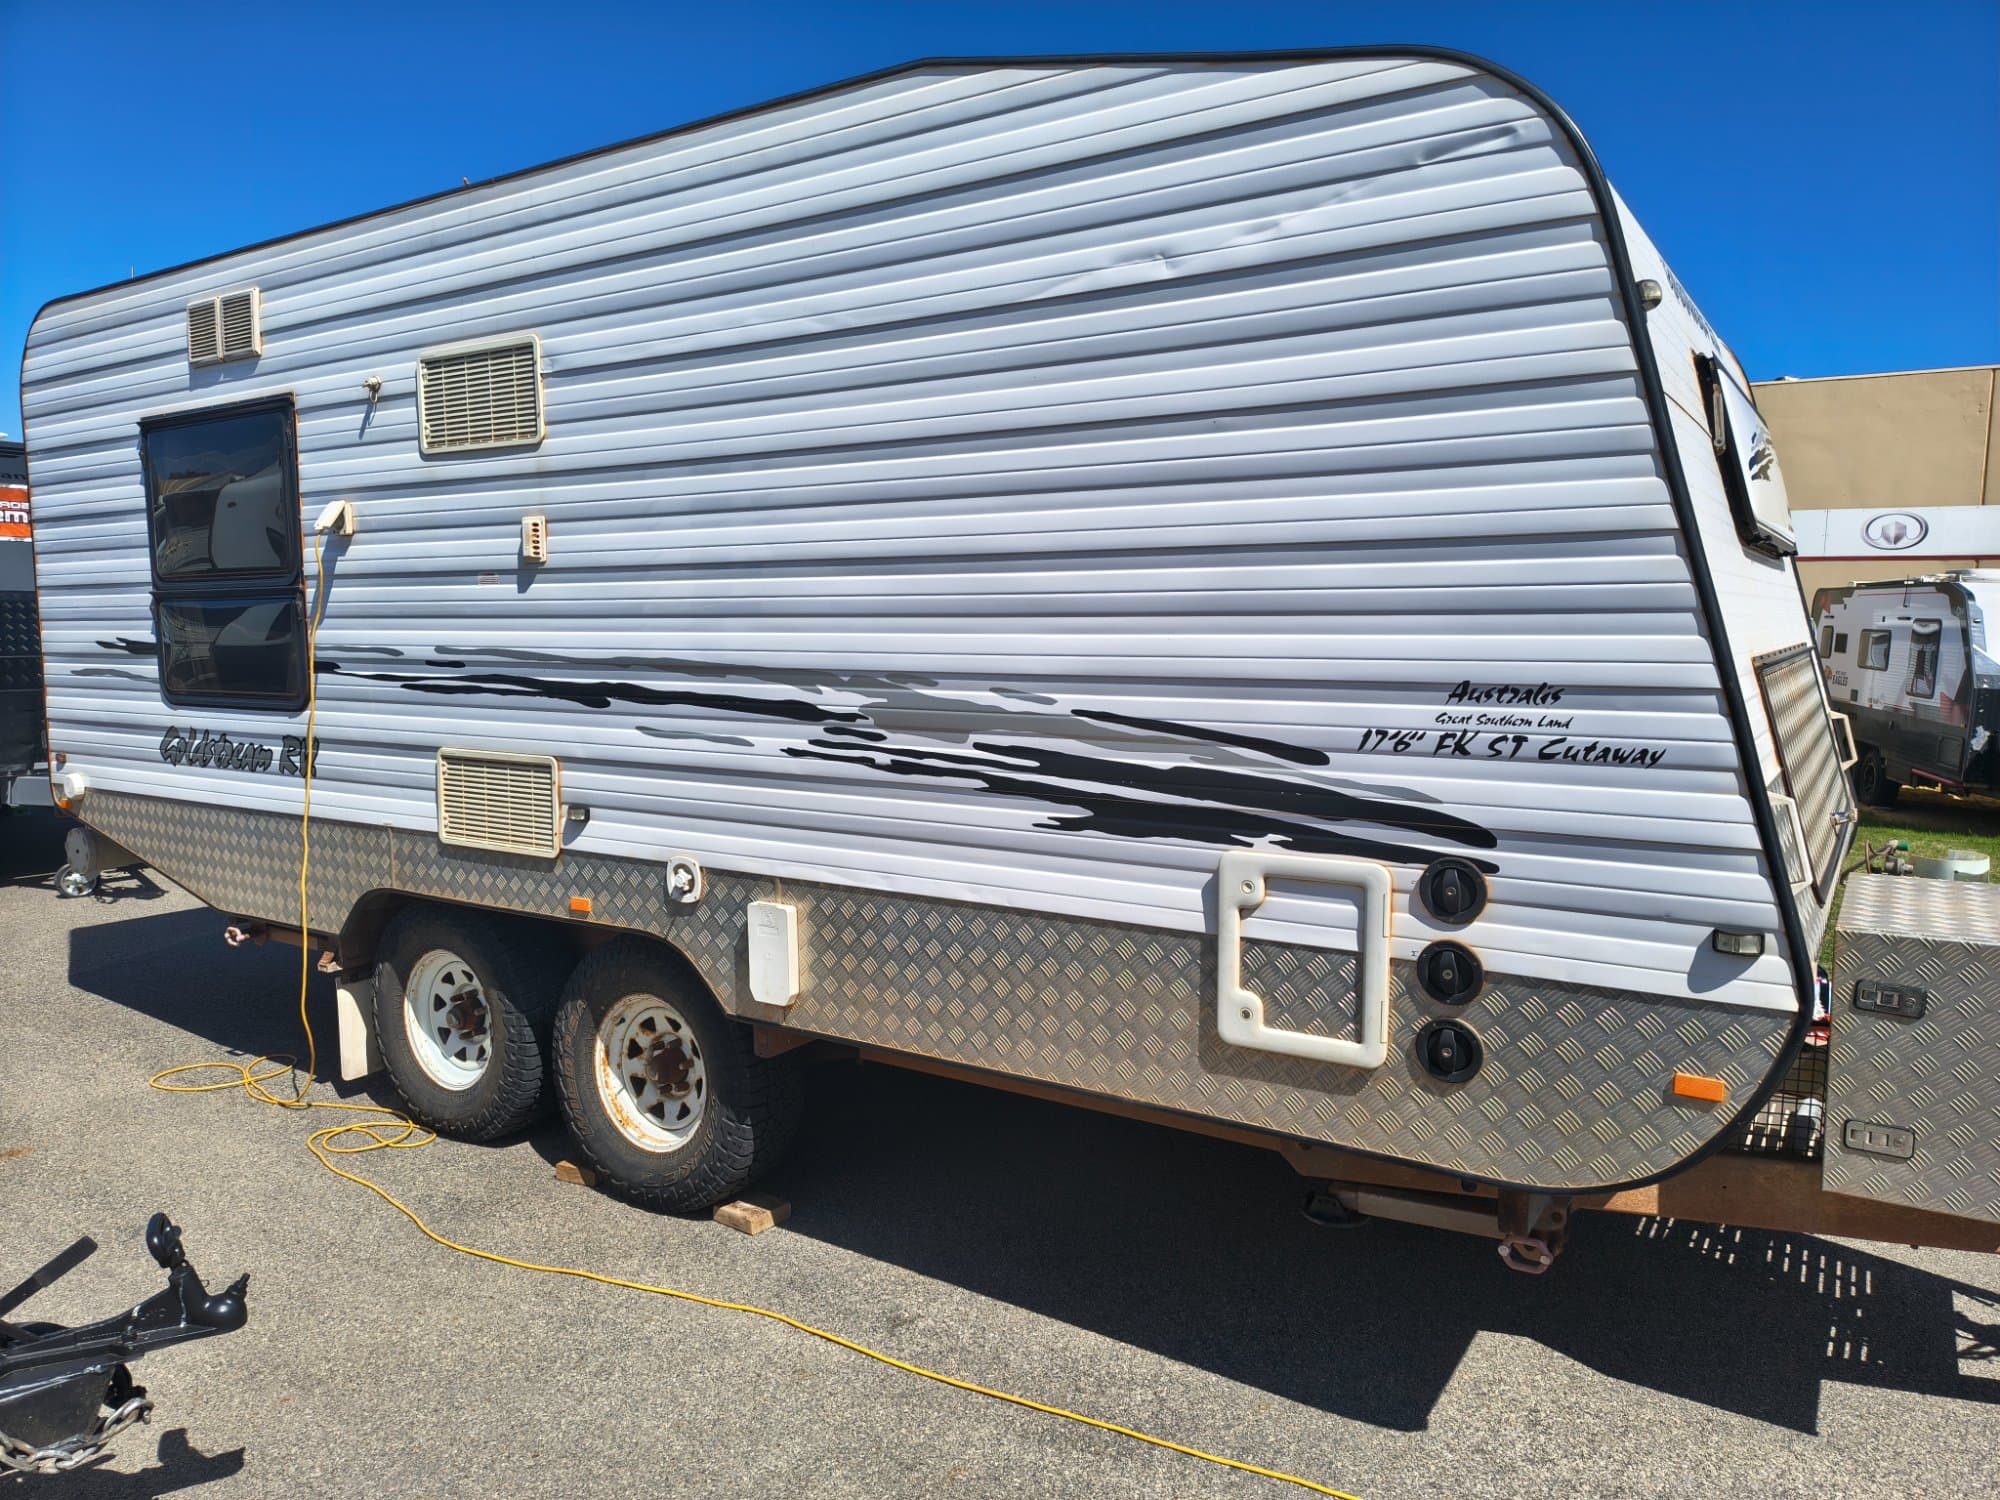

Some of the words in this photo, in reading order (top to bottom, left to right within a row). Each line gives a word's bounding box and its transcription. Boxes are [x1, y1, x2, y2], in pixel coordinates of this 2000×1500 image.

[1446, 680, 1566, 706] Australis
[1435, 711, 1472, 725] Great
[1476, 714, 1533, 728] Southern
[1537, 716, 1574, 730] Land
[160, 725, 273, 773] Goldstream
[1487, 734, 1529, 759] ST
[1538, 737, 1668, 769] Cutaway
